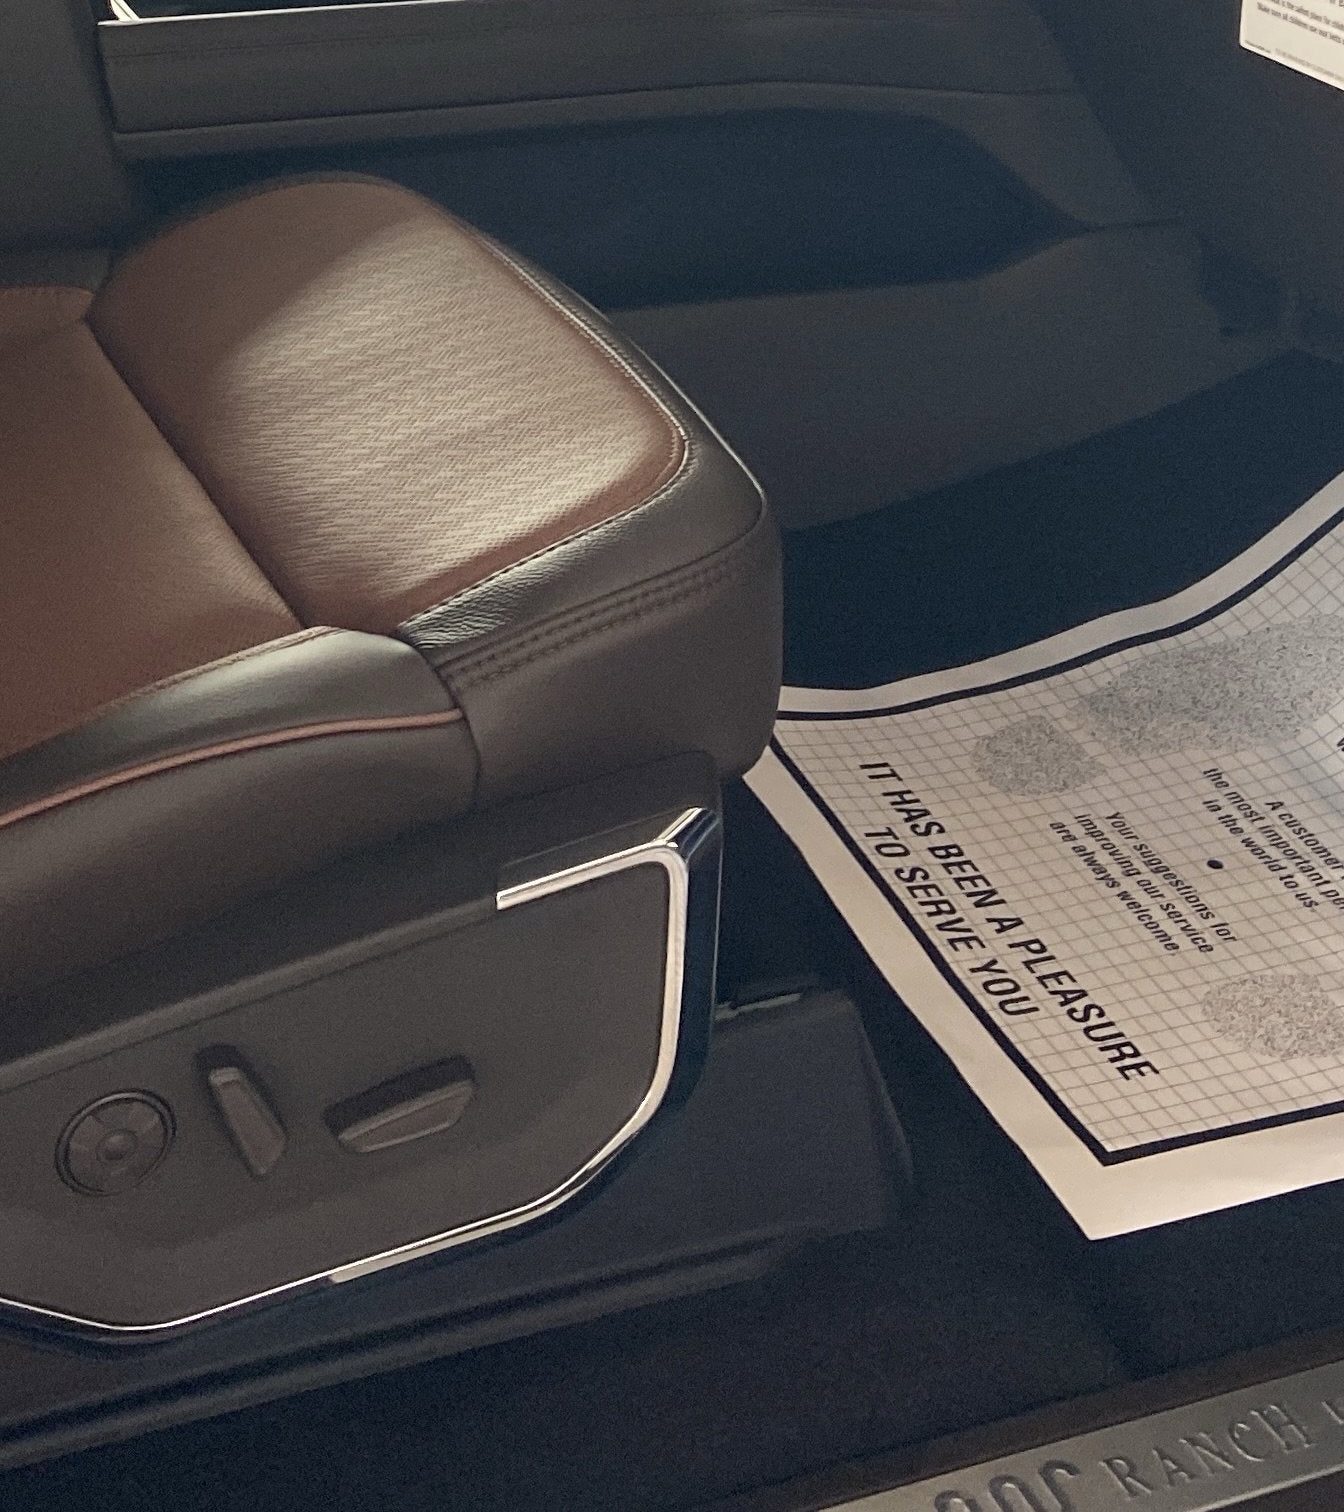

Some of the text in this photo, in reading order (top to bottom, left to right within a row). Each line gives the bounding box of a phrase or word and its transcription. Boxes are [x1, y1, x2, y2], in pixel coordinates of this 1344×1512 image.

[1202, 799, 1222, 813] in
[1218, 814, 1245, 836] the
[1240, 837, 1288, 873] world
[1279, 874, 1300, 889] to
[1203, 767, 1229, 789] the
[1224, 791, 1266, 824] most
[1258, 824, 1331, 888] important
[1265, 800, 1285, 811] A
[859, 762, 1160, 1081] IT HAS BEEN A PLEASURE
[864, 826, 1040, 1016] TO SERVE YOU
[1049, 821, 1180, 956] are always welcome.
[1074, 813, 1214, 953] improving our service
[1105, 811, 1238, 942] Your suggestions for
[1098, 1403, 1316, 1501] RANCH
